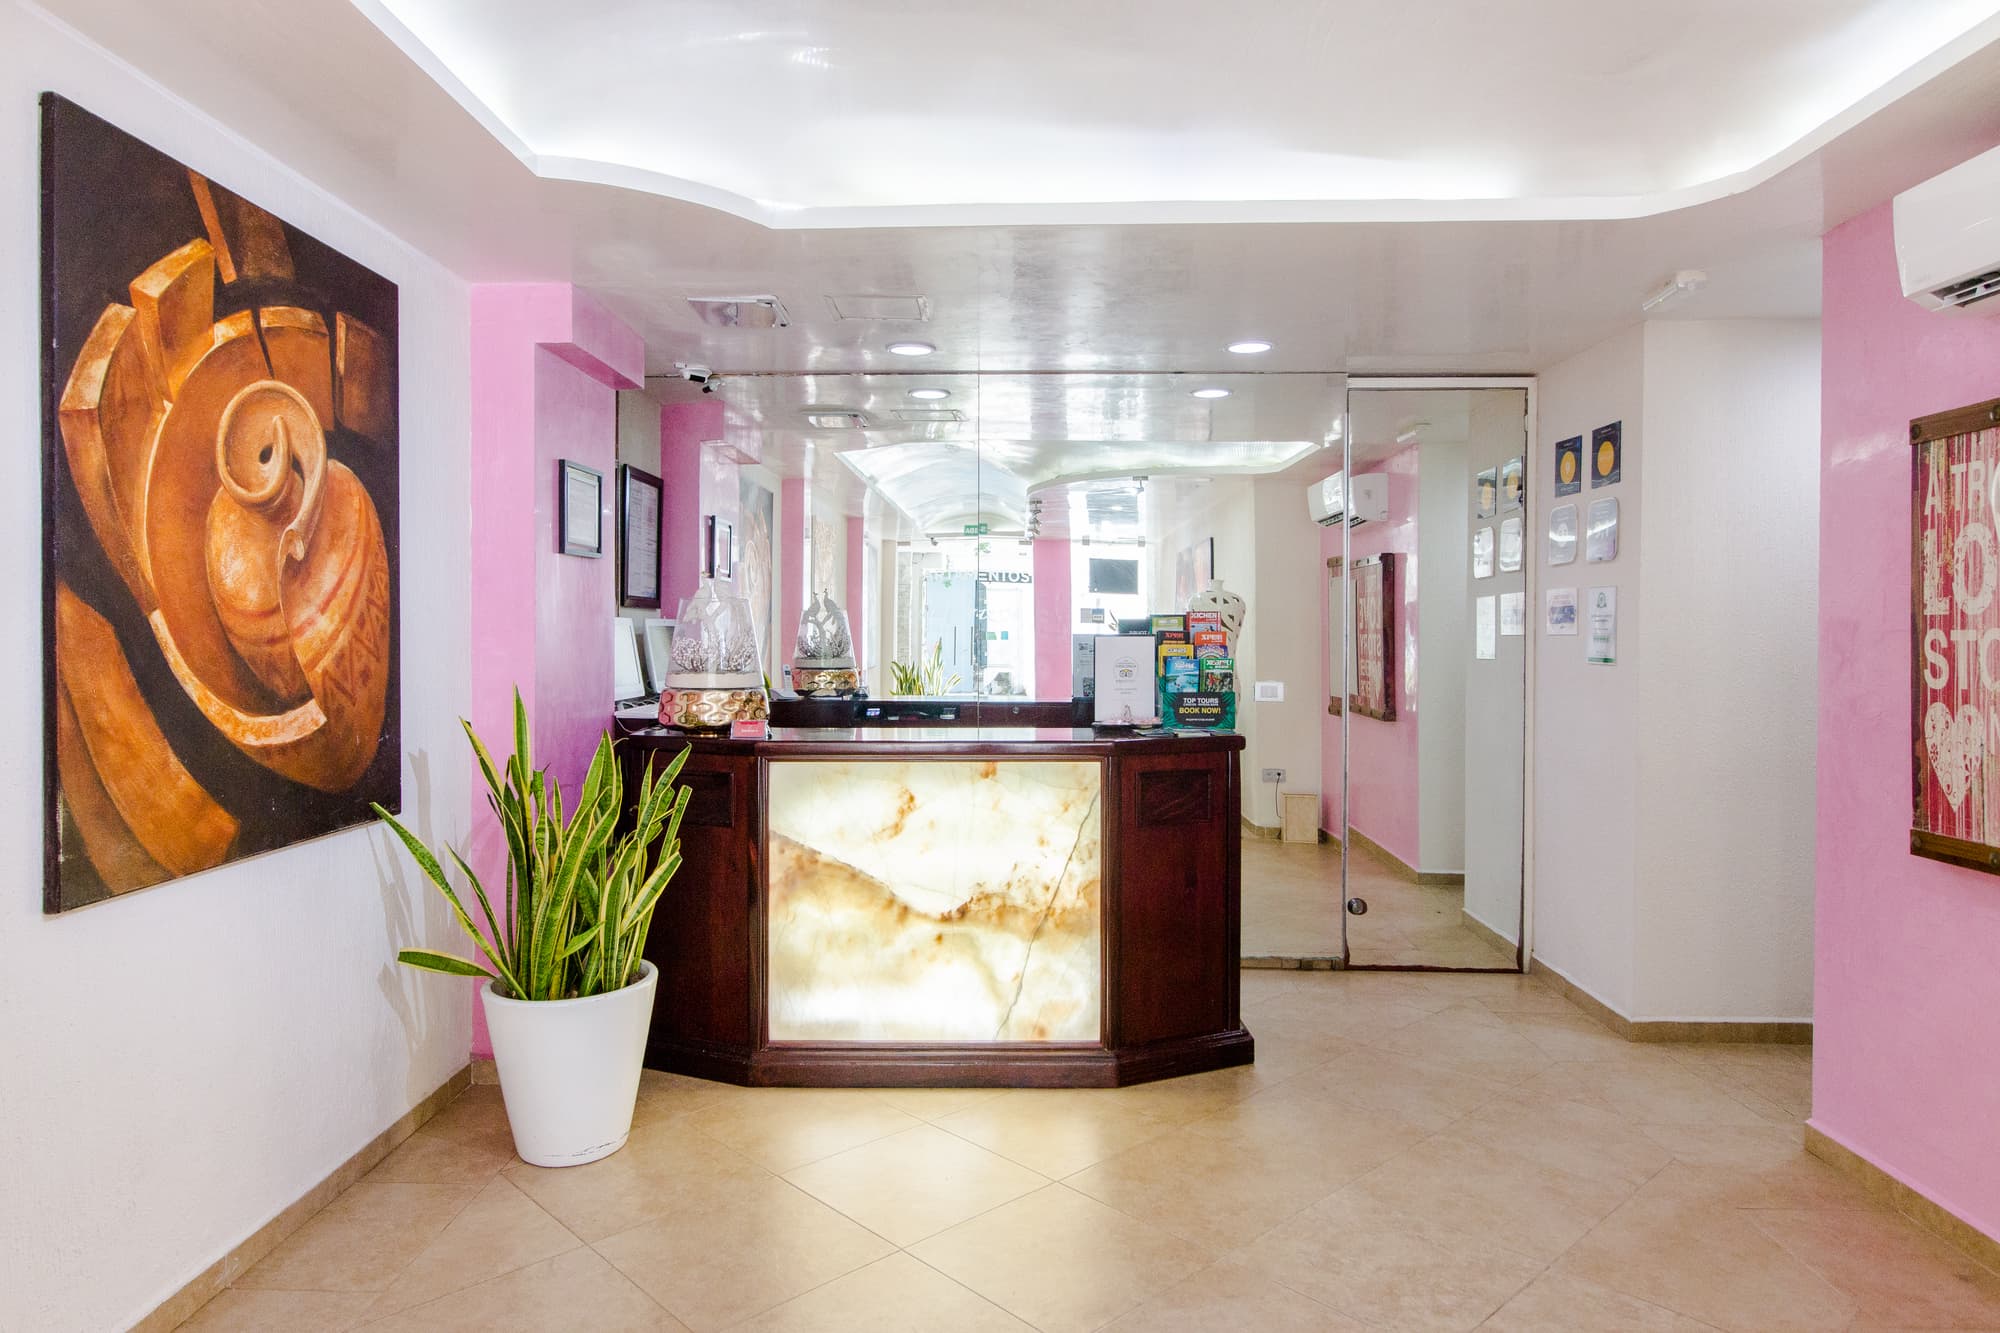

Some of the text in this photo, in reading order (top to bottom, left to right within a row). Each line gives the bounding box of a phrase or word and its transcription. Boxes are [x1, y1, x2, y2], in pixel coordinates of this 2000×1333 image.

[1924, 460, 1942, 515] A
[1178, 706, 1221, 714] BOOK NOW!
